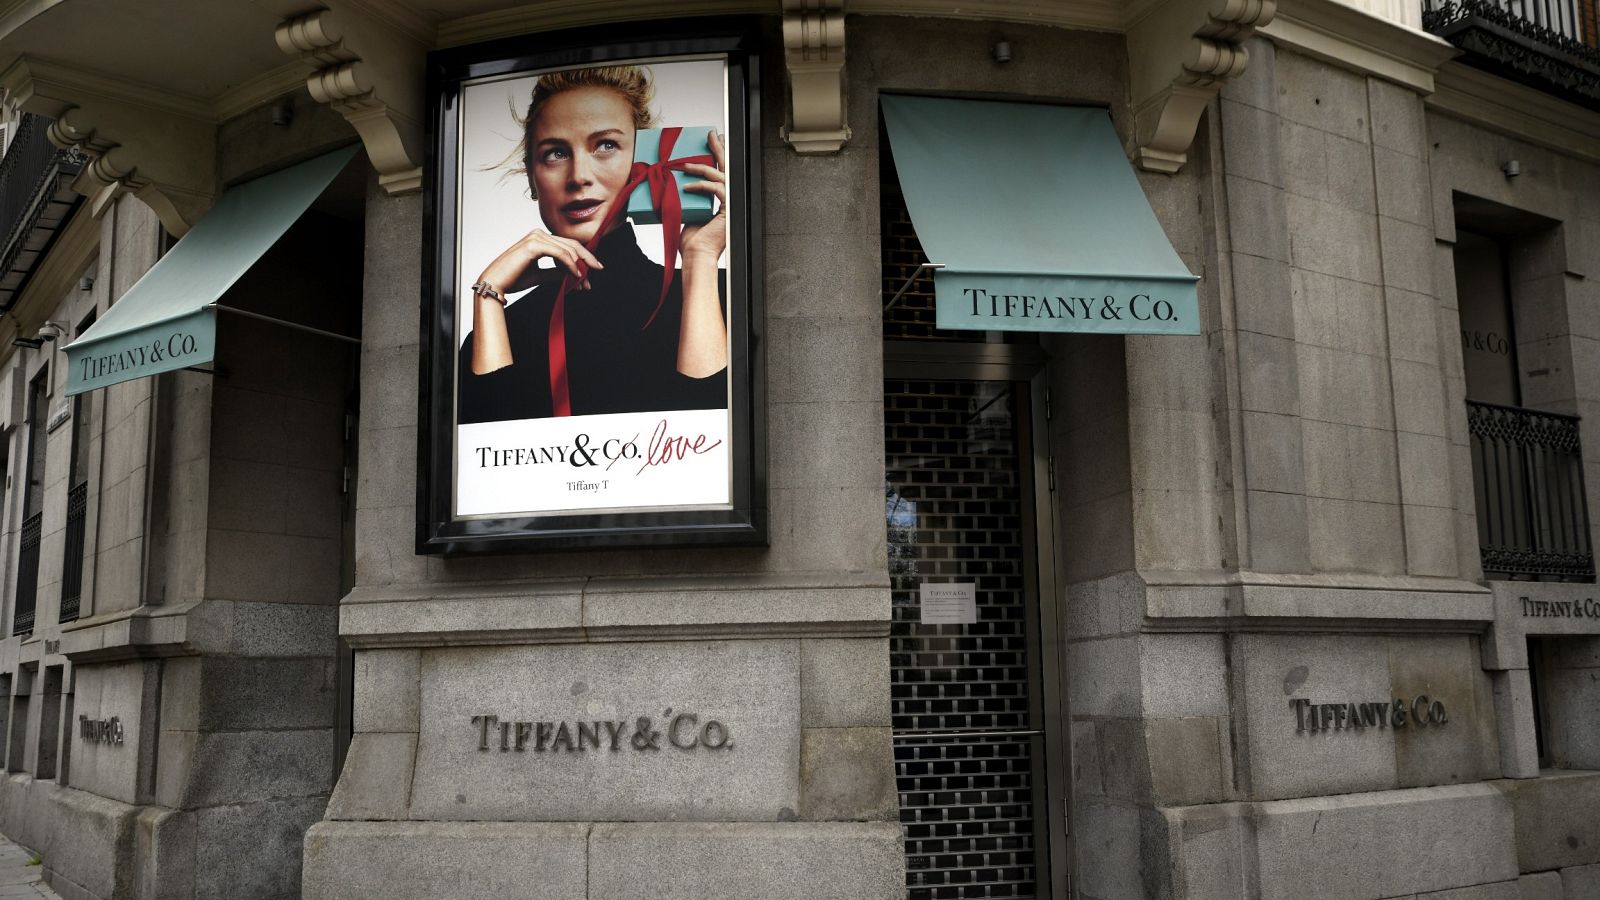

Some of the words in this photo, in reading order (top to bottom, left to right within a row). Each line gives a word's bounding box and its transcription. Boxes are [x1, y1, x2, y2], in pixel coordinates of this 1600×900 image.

[963, 288, 1096, 320] TIFFANY
[1100, 295, 1124, 321] &
[80, 345, 149, 381] TIFFANY
[150, 339, 166, 363] &
[475, 445, 570, 468] TIFFANY
[569, 433, 600, 468] &
[636, 419, 722, 476] love
[566, 480, 600, 493] Tiffany
[602, 479, 610, 490] T
[1519, 596, 1572, 618] TIFFANY
[1573, 599, 1583, 618] &
[1289, 698, 1391, 731] TIFFANY
[1391, 699, 1408, 728] &
[471, 714, 626, 752] TIFFANY
[630, 715, 661, 751] &
